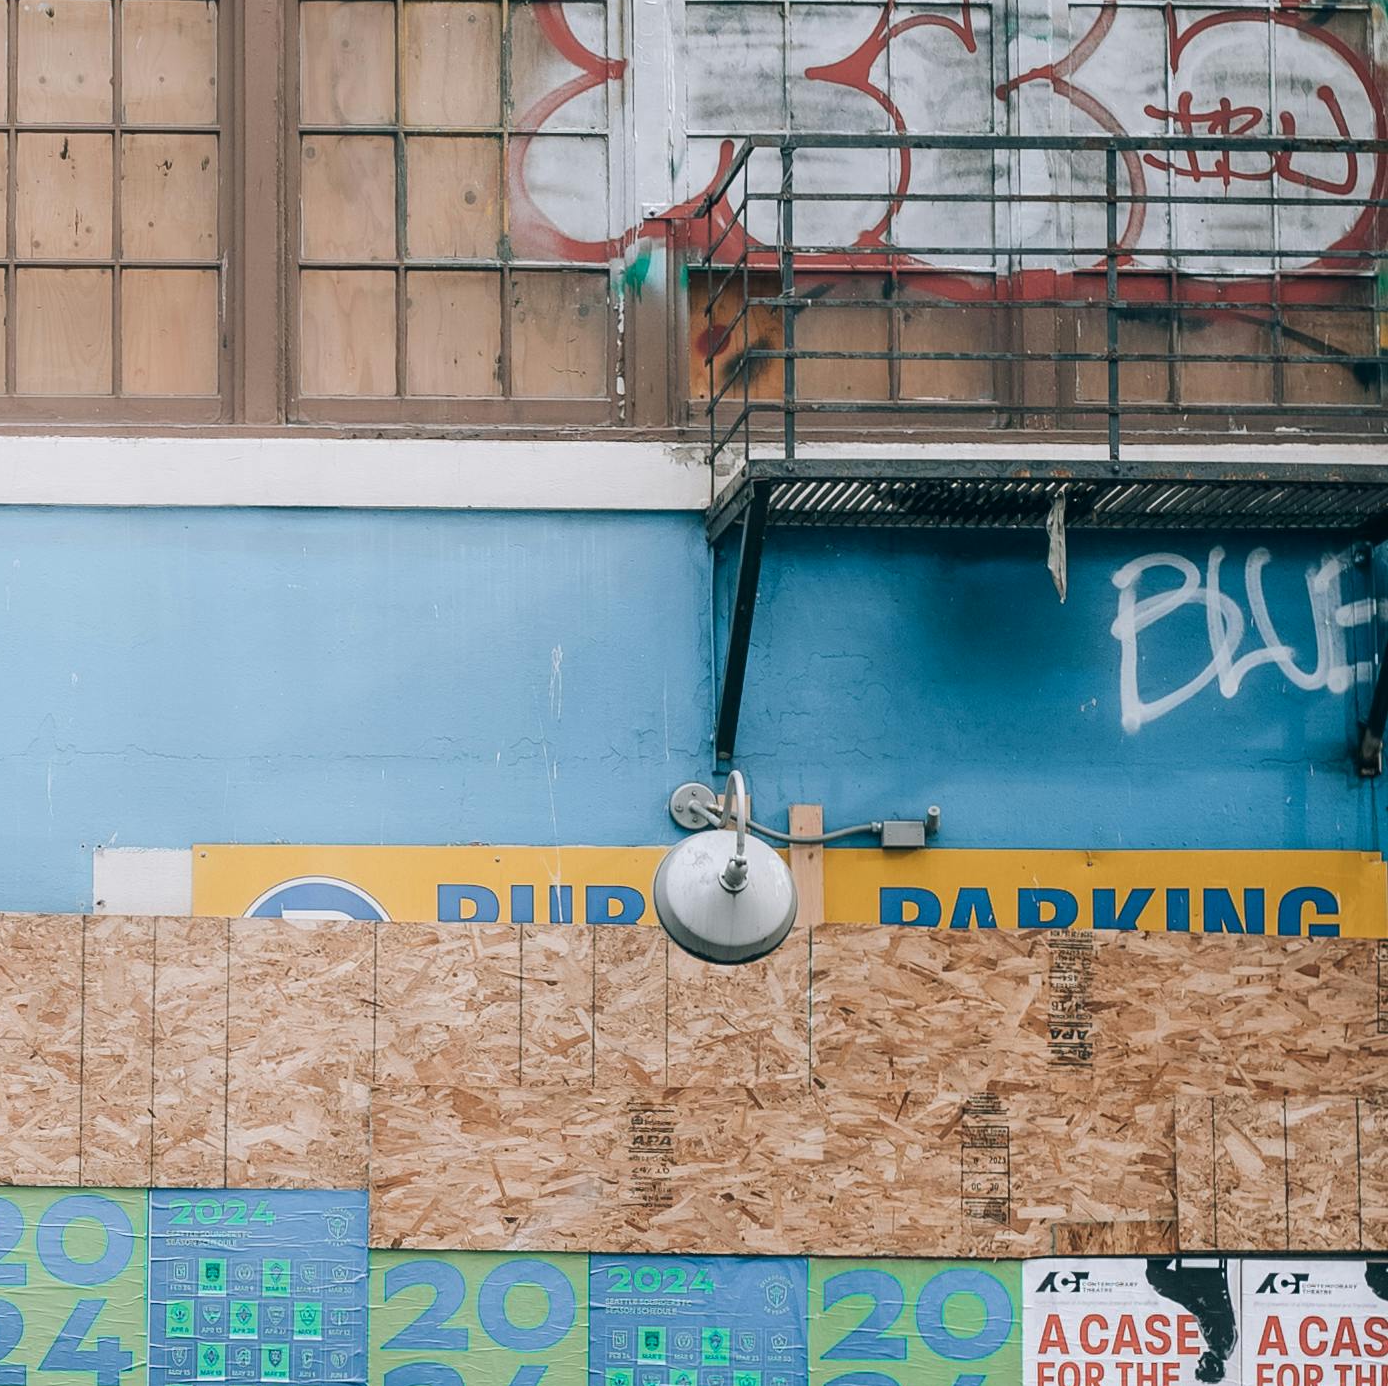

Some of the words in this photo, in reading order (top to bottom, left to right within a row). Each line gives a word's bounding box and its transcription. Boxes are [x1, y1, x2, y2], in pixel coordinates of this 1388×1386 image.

[879, 886, 1341, 937] PARKING
[632, 1135, 672, 1146] APA
[169, 1198, 276, 1226] 2024
[607, 1266, 716, 1294] 2024
[1035, 1271, 1090, 1293] ACT
[1255, 1272, 1310, 1294] ACT
[380, 1258, 576, 1353] 20
[820, 1268, 1013, 1361] 20
[1038, 1313, 1070, 1355] A
[1079, 1313, 1201, 1356] CASE
[1257, 1315, 1289, 1356] A
